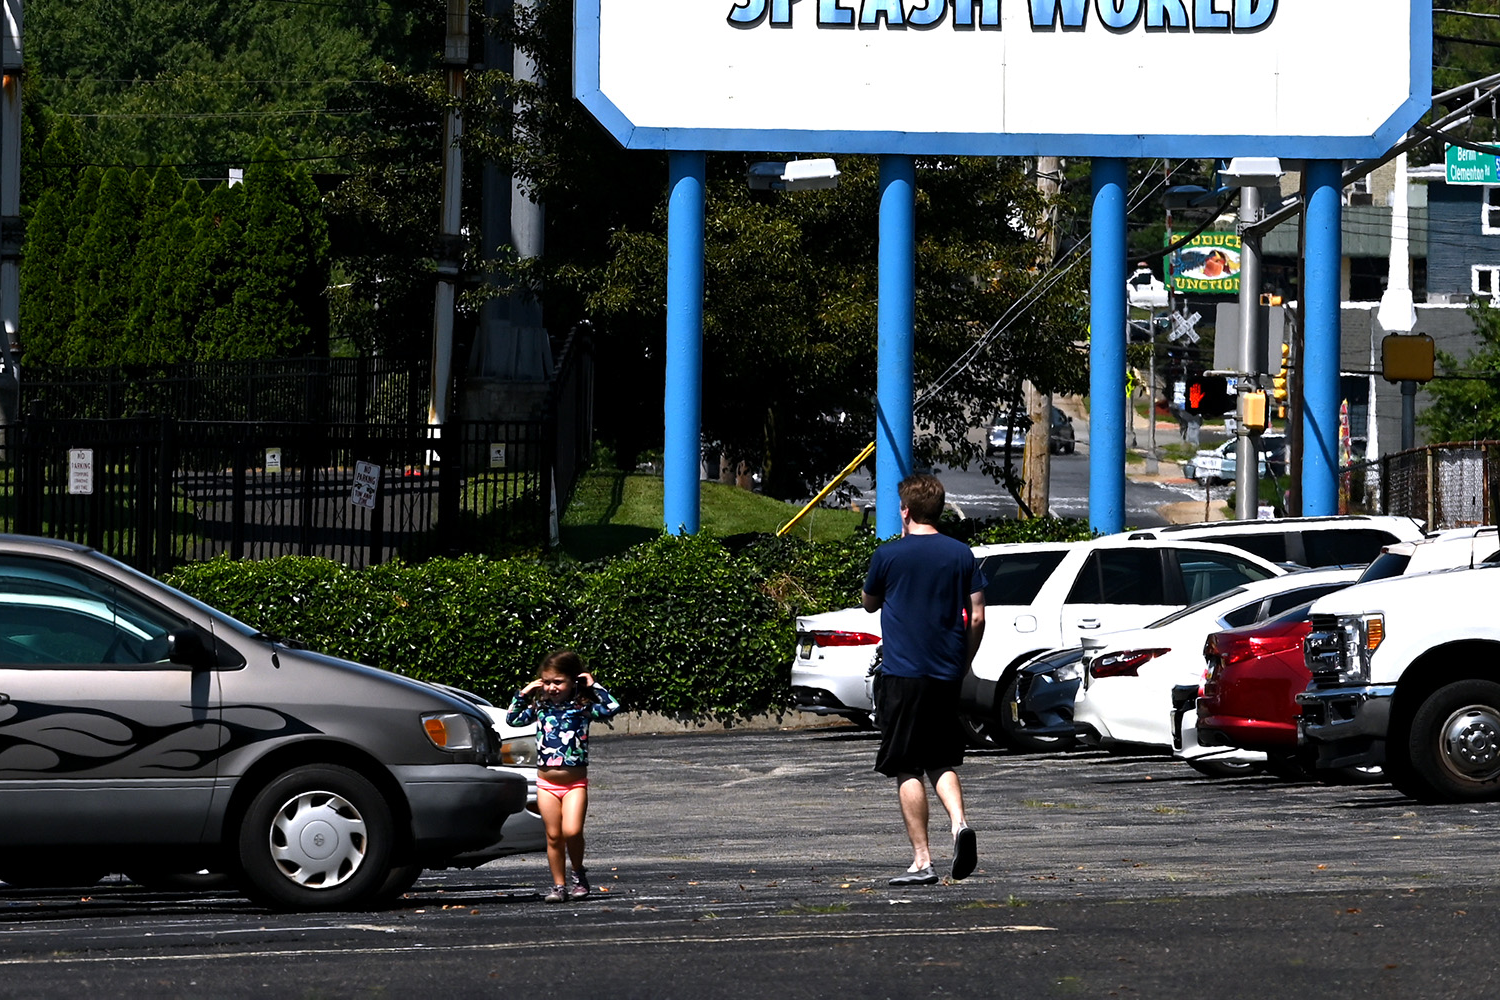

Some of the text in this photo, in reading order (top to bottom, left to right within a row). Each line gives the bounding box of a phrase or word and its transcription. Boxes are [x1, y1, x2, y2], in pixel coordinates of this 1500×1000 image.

[1450, 164, 1484, 180] Clementon
[364, 465, 372, 475] NO
[357, 472, 376, 485] PARKING
